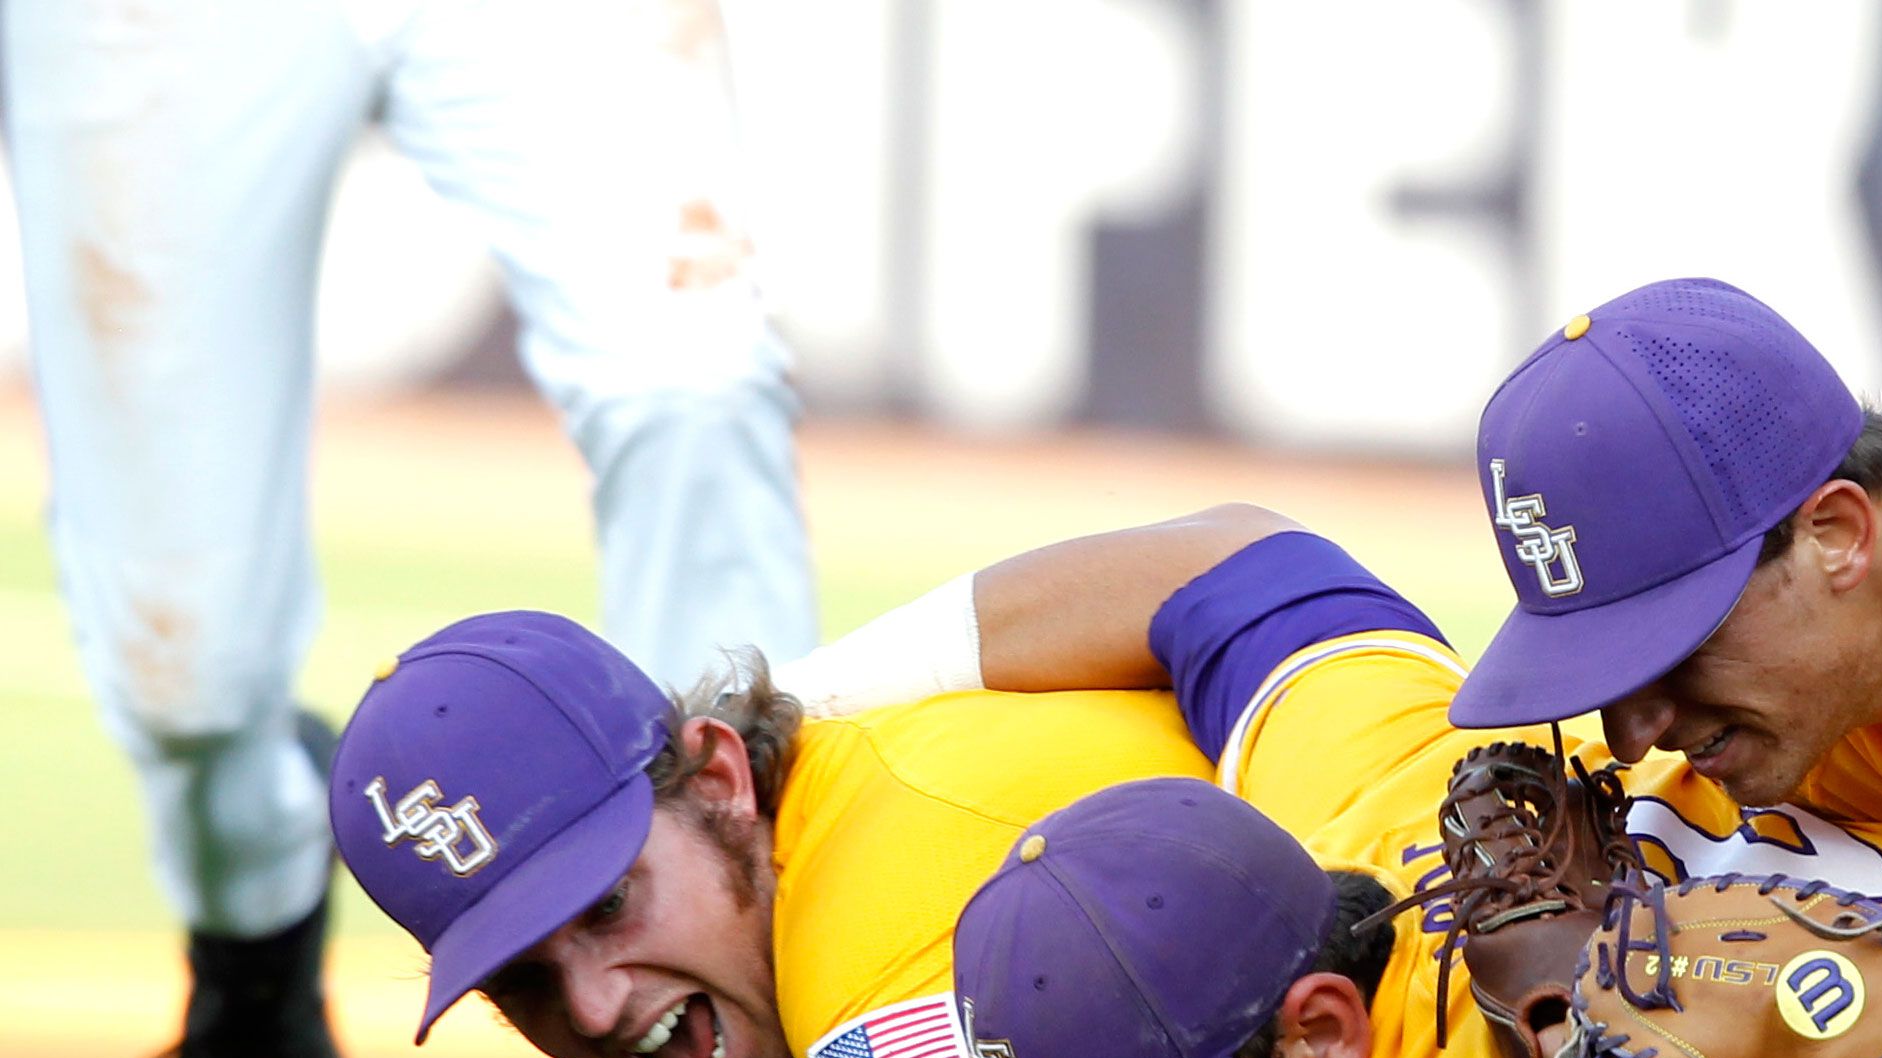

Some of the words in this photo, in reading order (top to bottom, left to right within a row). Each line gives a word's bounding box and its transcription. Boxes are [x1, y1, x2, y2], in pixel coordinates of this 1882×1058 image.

[1490, 458, 1586, 599] LSU
[363, 775, 498, 878] LSU
[1645, 954, 1690, 979] #2
[1692, 957, 1779, 985] LSU
